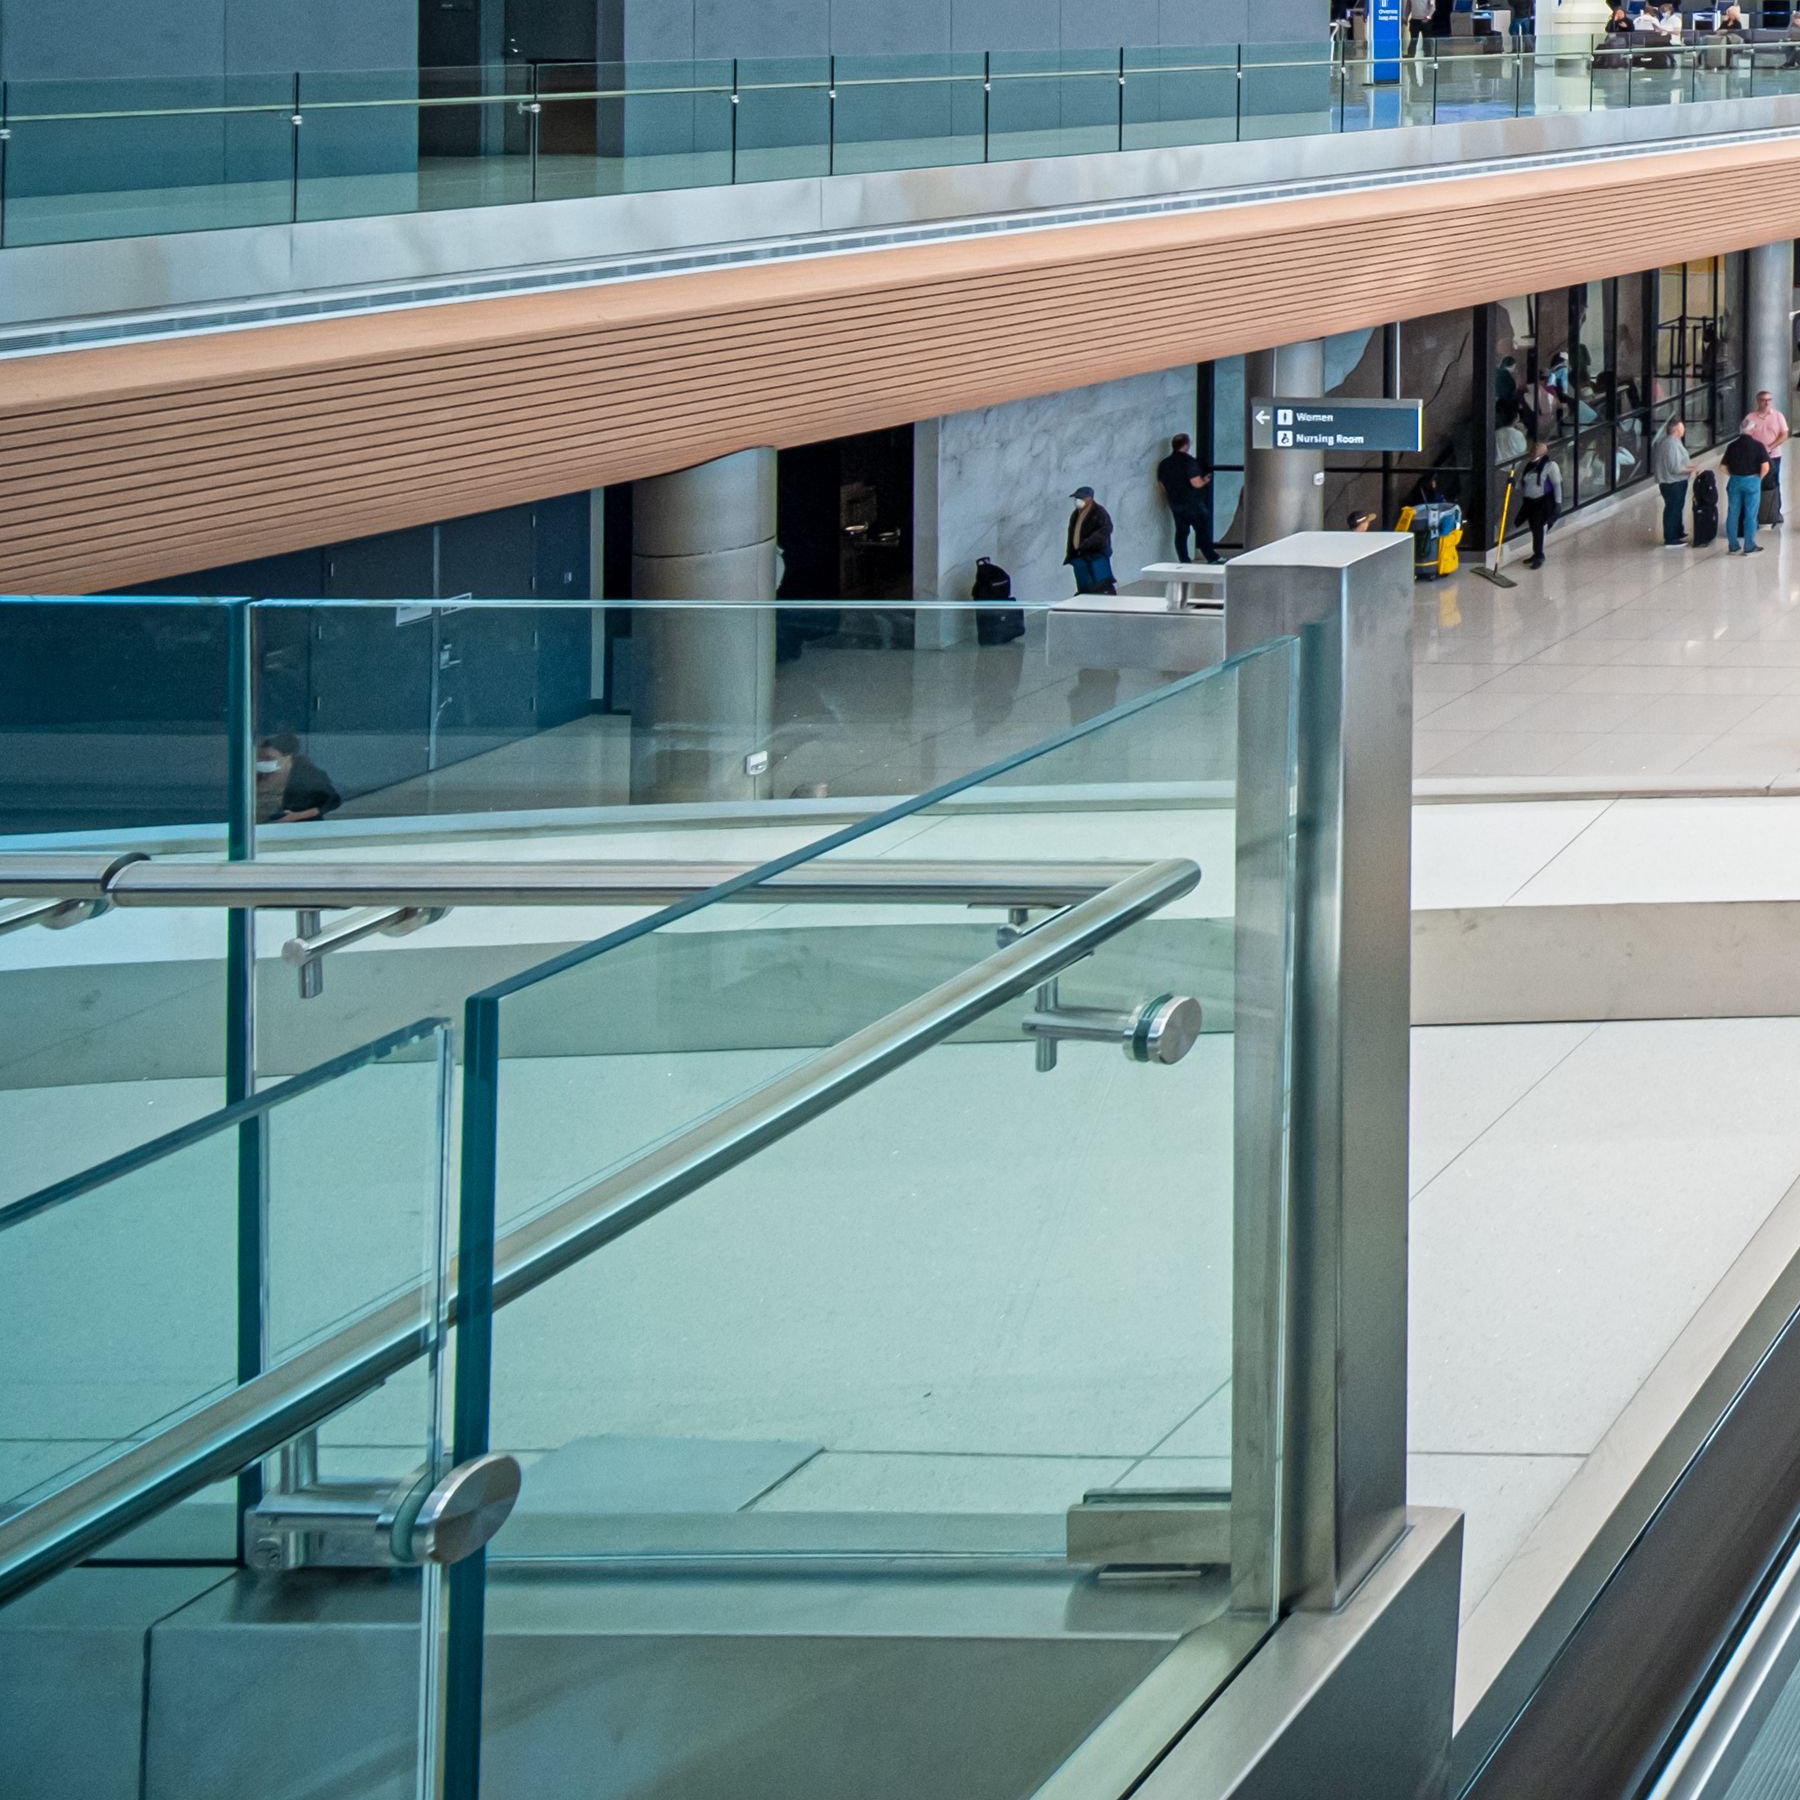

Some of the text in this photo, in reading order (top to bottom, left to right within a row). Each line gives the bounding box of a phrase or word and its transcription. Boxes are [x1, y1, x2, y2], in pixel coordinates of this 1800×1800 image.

[1296, 412, 1334, 422] Women
[1296, 434, 1365, 446] Nursing Room
